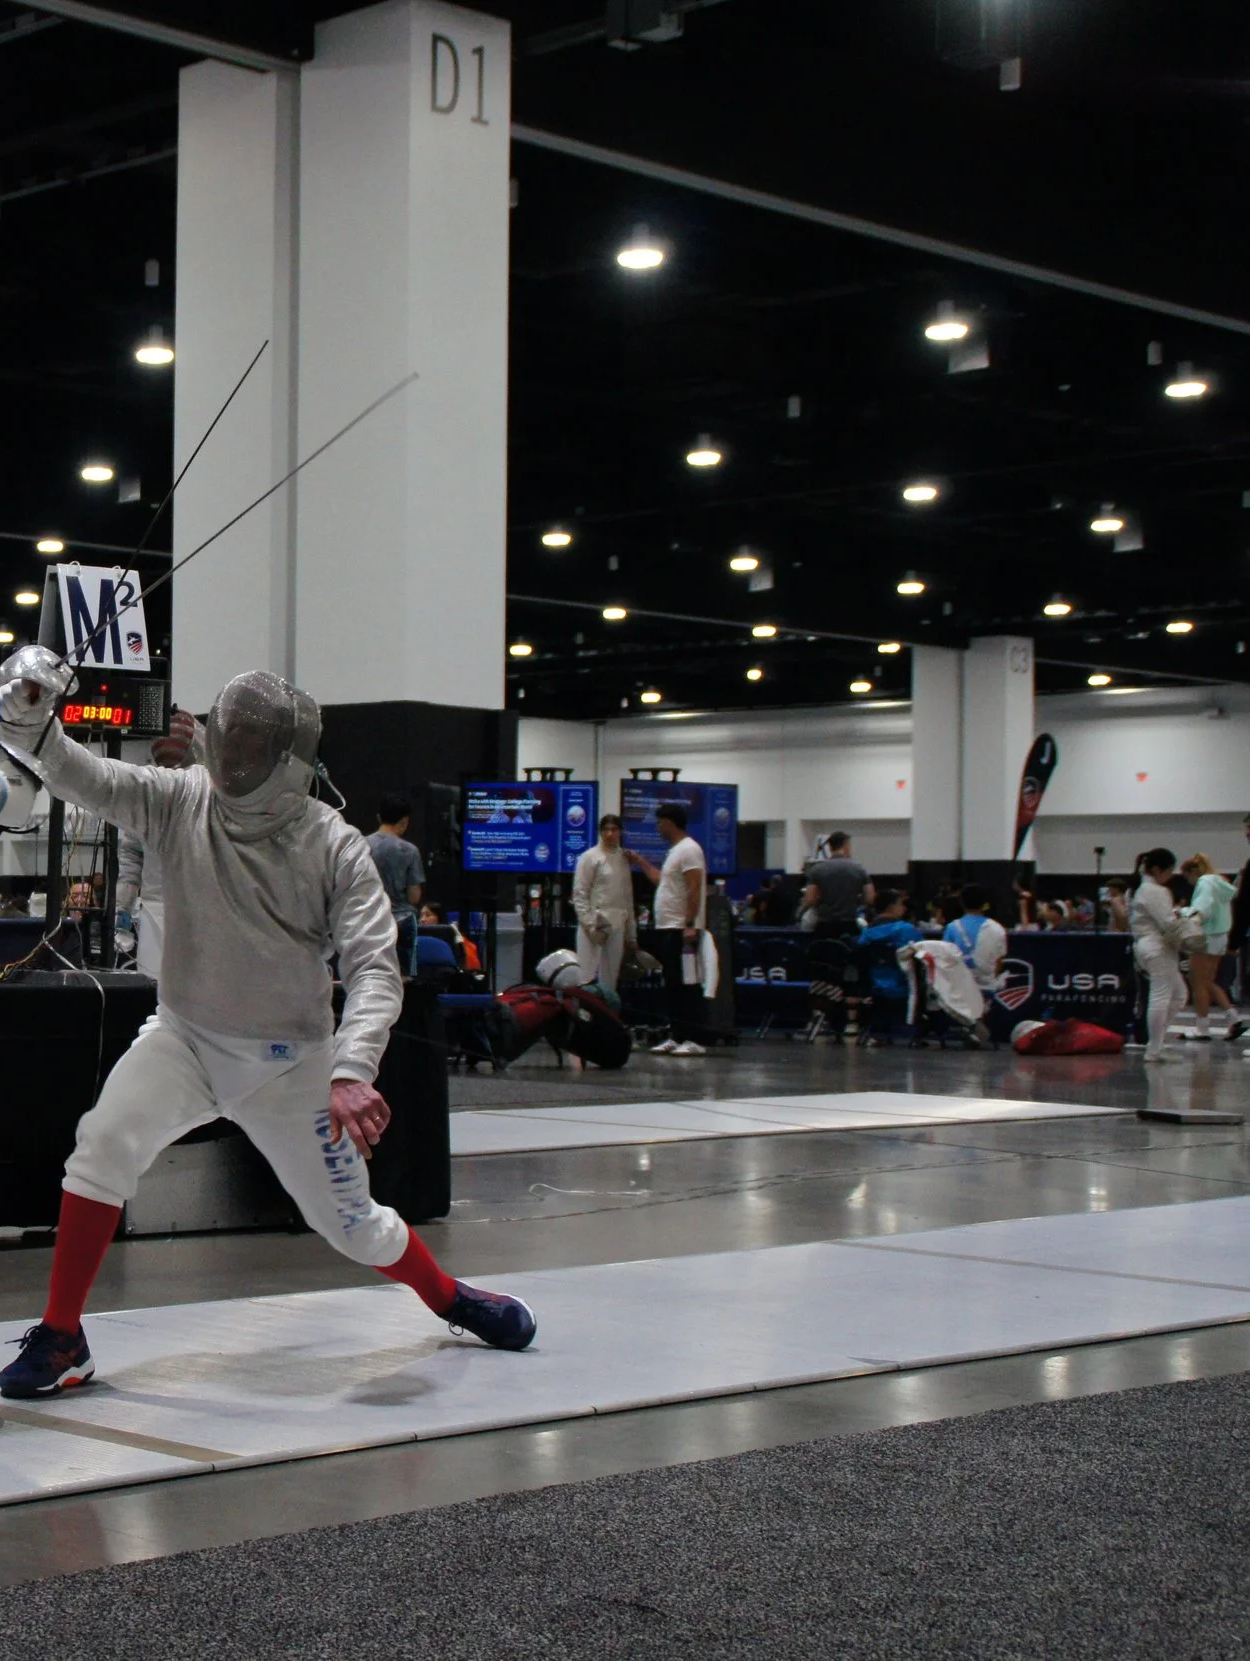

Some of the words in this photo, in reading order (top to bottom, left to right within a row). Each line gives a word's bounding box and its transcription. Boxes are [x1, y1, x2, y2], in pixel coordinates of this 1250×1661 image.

[431, 32, 489, 127] D1
[64, 705, 82, 721] 02
[83, 706, 112, 719] 03:00
[113, 708, 131, 725] 01
[1047, 973, 1120, 990] USA
